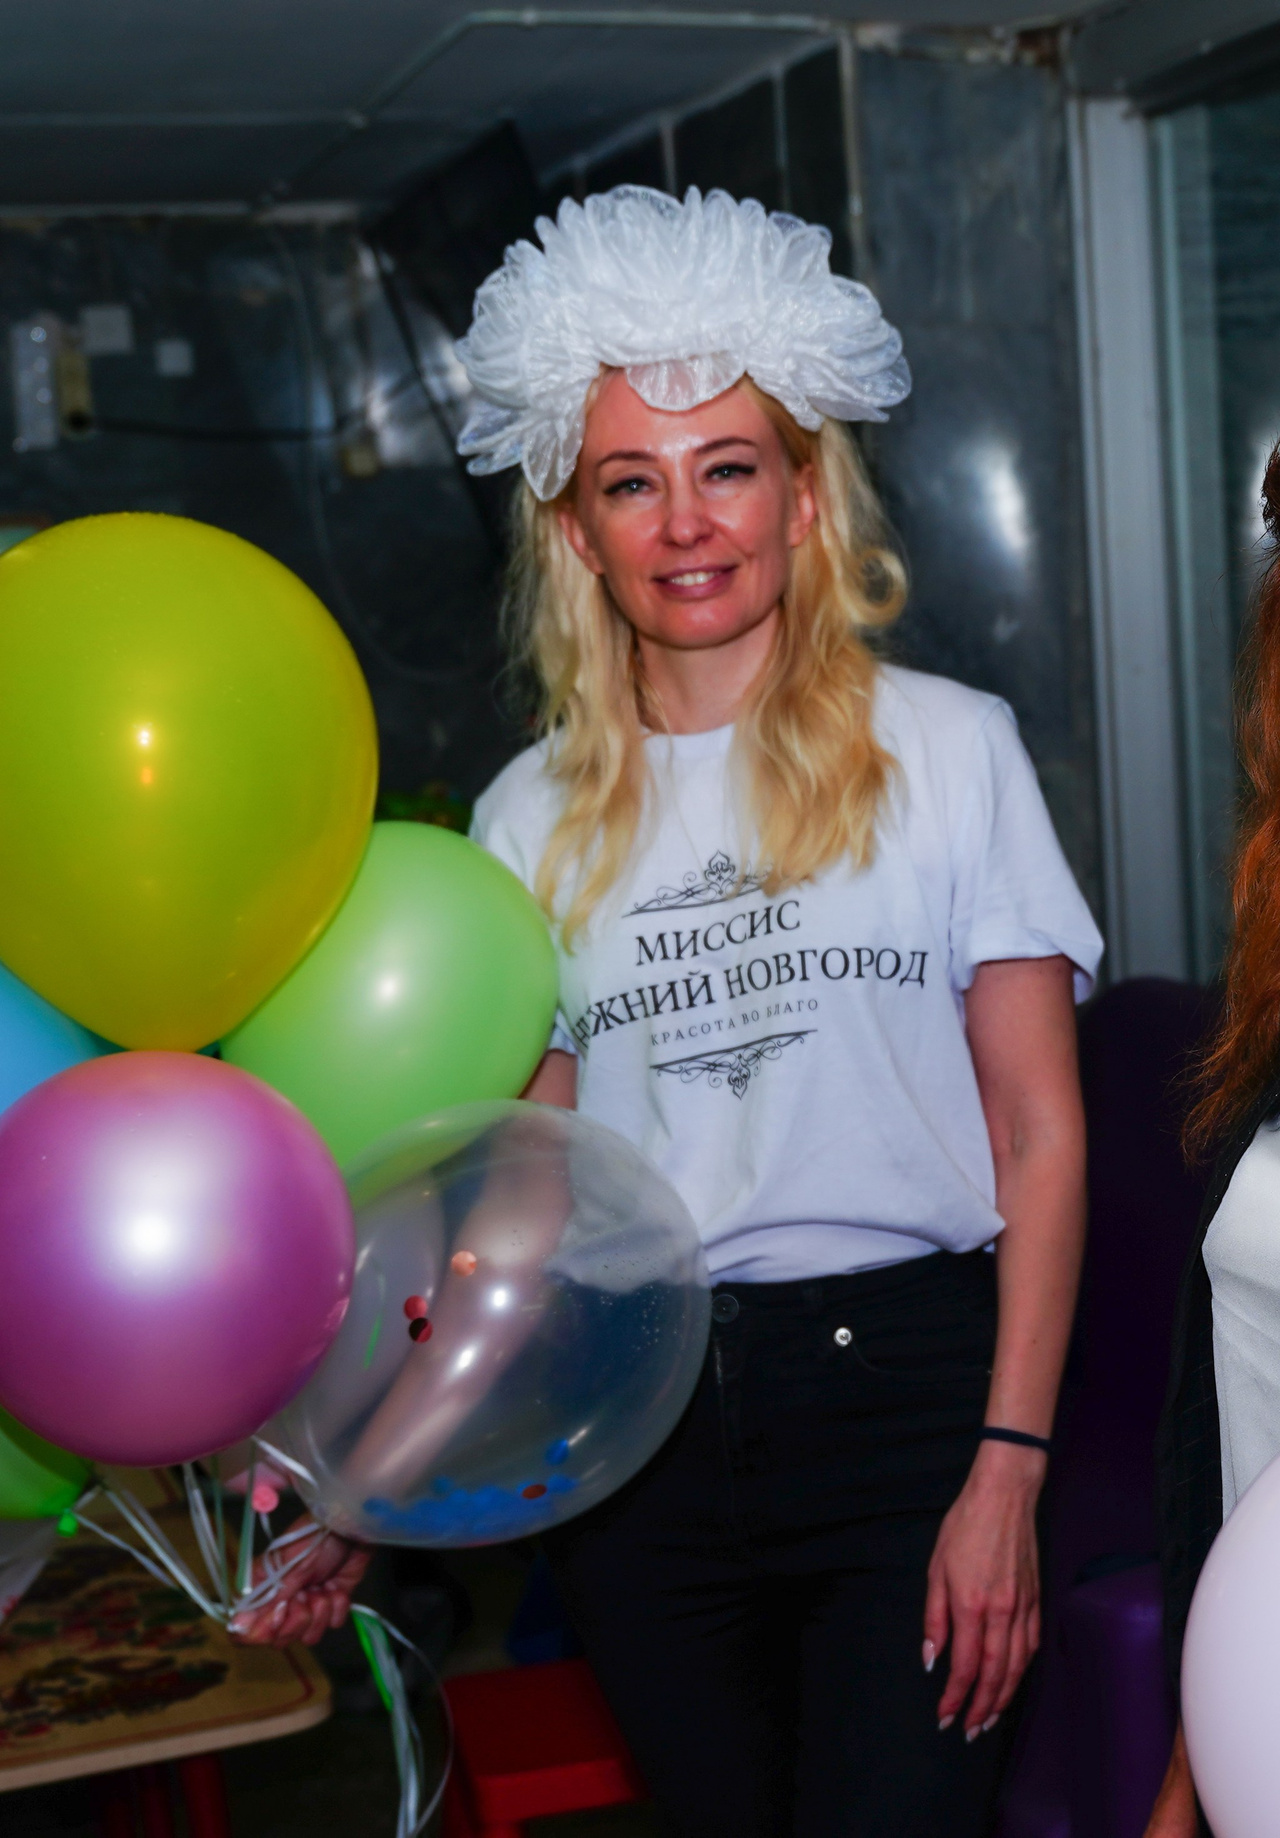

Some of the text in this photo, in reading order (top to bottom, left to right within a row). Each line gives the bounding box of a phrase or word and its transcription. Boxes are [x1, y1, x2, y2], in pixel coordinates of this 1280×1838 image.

[634, 900, 801, 966] МИССИС
[724, 947, 930, 1001] НОВГОРОД
[650, 998, 820, 1047] КРАСОТА ВО БЛАГО
